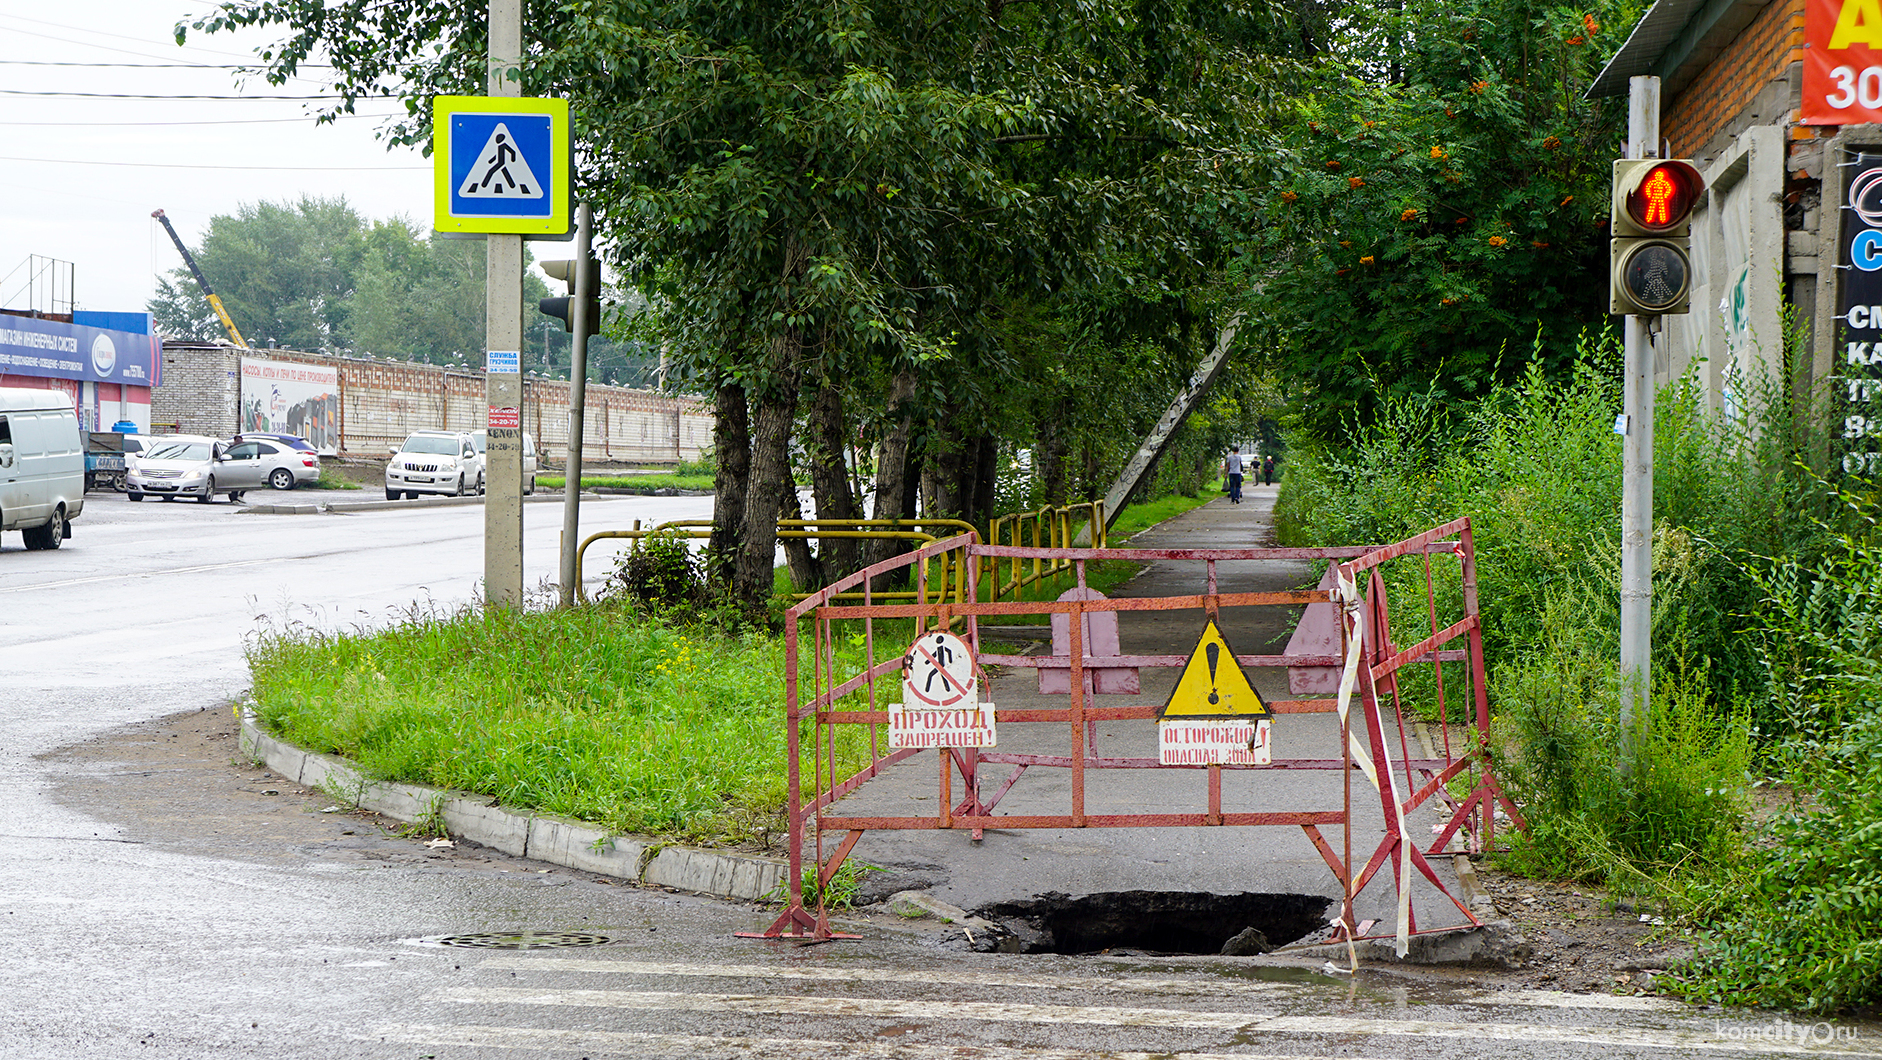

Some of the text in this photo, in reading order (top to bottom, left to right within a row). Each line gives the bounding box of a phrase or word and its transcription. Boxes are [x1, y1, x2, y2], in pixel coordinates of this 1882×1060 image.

[291, 370, 297, 380] ПО
[297, 370, 307, 381] ЦЕНЕ
[487, 428, 519, 438] XENON
[894, 711, 988, 730] ПРОХОД
[894, 730, 992, 747] ЗАПРЕЩЕН!
[1164, 749, 1218, 763] ОПАСНАЯ
